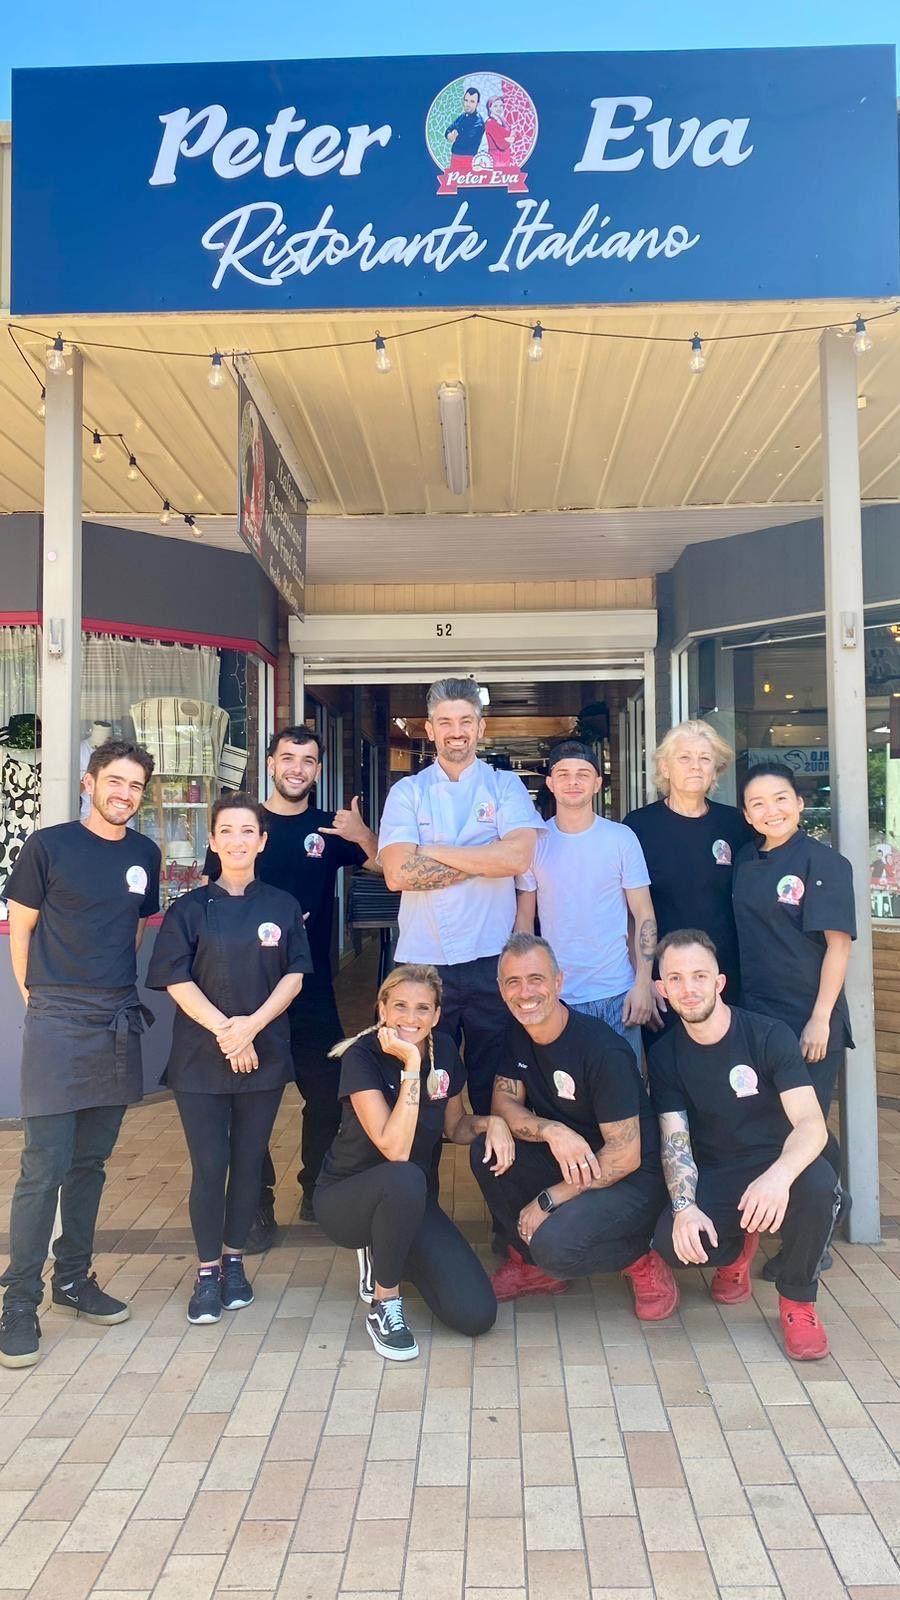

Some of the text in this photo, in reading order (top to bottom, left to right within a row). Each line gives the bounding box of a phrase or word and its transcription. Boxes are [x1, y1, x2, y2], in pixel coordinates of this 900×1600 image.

[149, 95, 753, 186] Peter Eva
[446, 170, 519, 186] Peter Eva
[201, 198, 700, 289] Ristorante Italiano
[276, 457, 298, 512] Italian
[436, 623, 452, 637] 52
